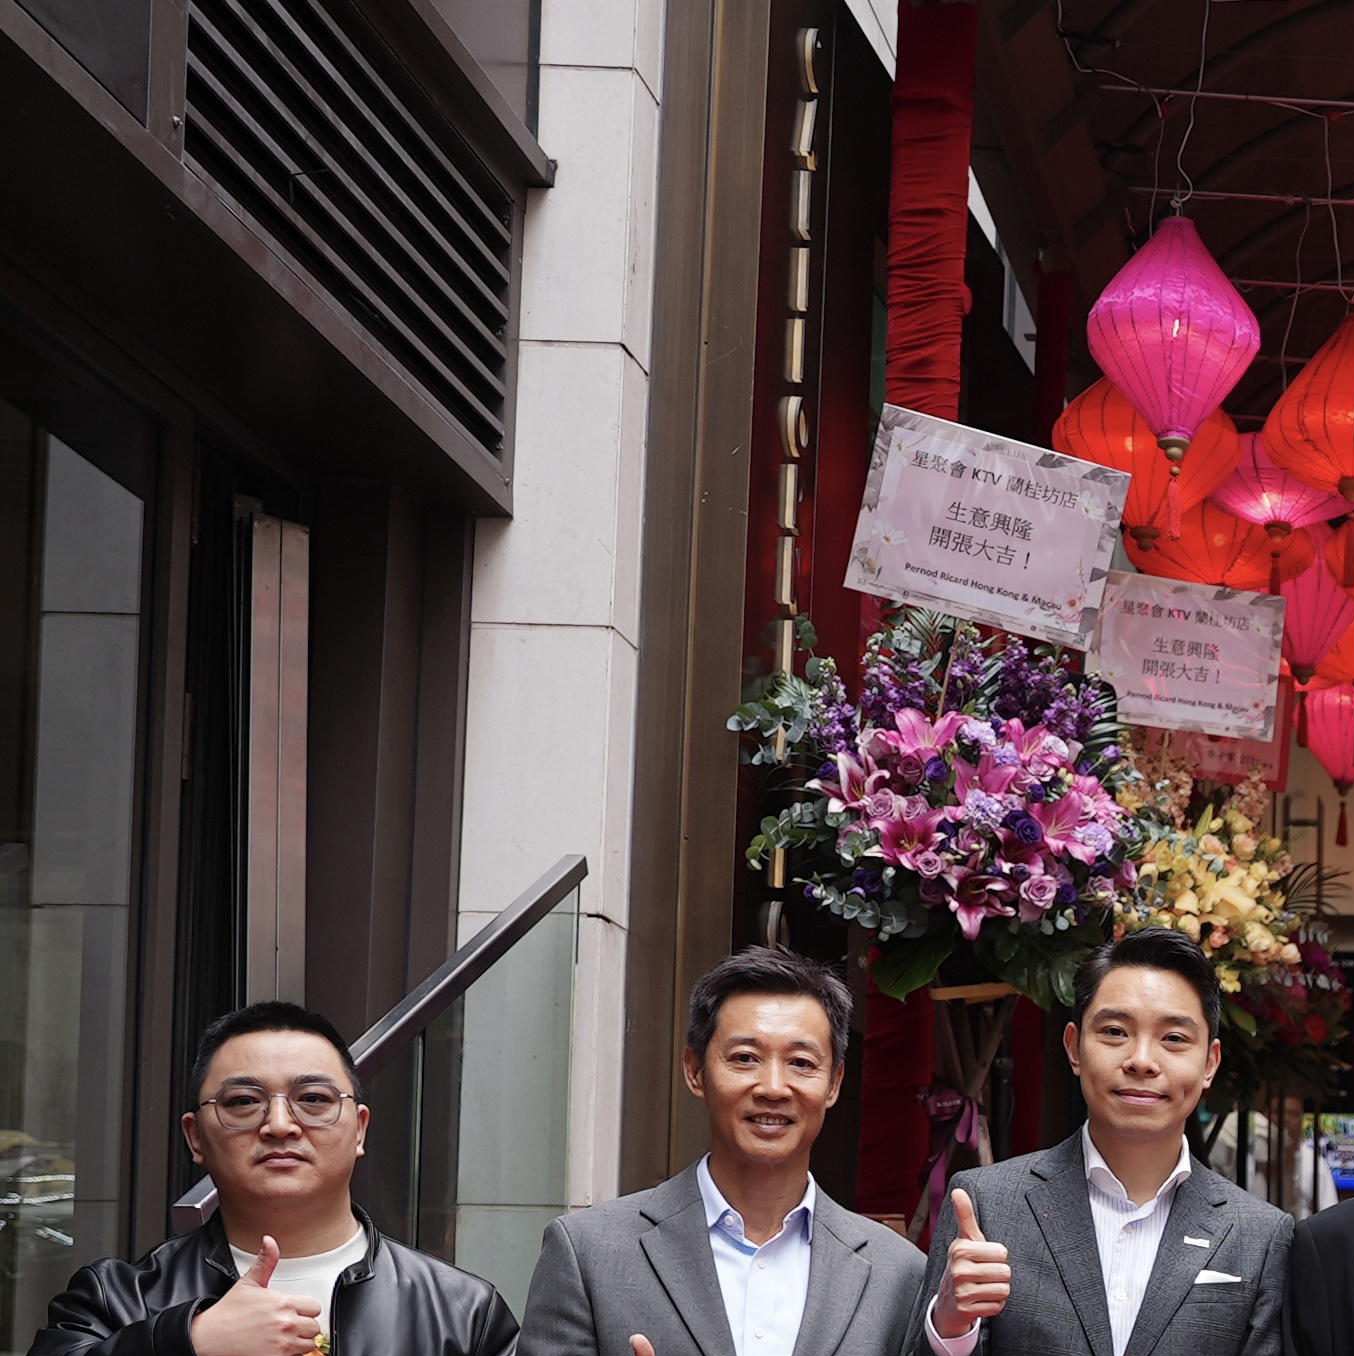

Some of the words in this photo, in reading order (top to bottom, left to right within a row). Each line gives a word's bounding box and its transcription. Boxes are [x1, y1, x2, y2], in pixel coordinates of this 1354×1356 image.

[910, 448, 968, 481] 星聚會
[971, 466, 1003, 487] KTV
[1005, 476, 1080, 511] 蘭桂坊店
[945, 500, 1035, 543] 生意興隆
[904, 562, 939, 579] Pernod
[940, 571, 970, 587] Ricard
[971, 579, 995, 595] Hong
[996, 586, 1020, 602] Kong
[1021, 592, 1029, 602] &
[1031, 595, 1063, 611] Macau
[1167, 608, 1192, 621] KTV
